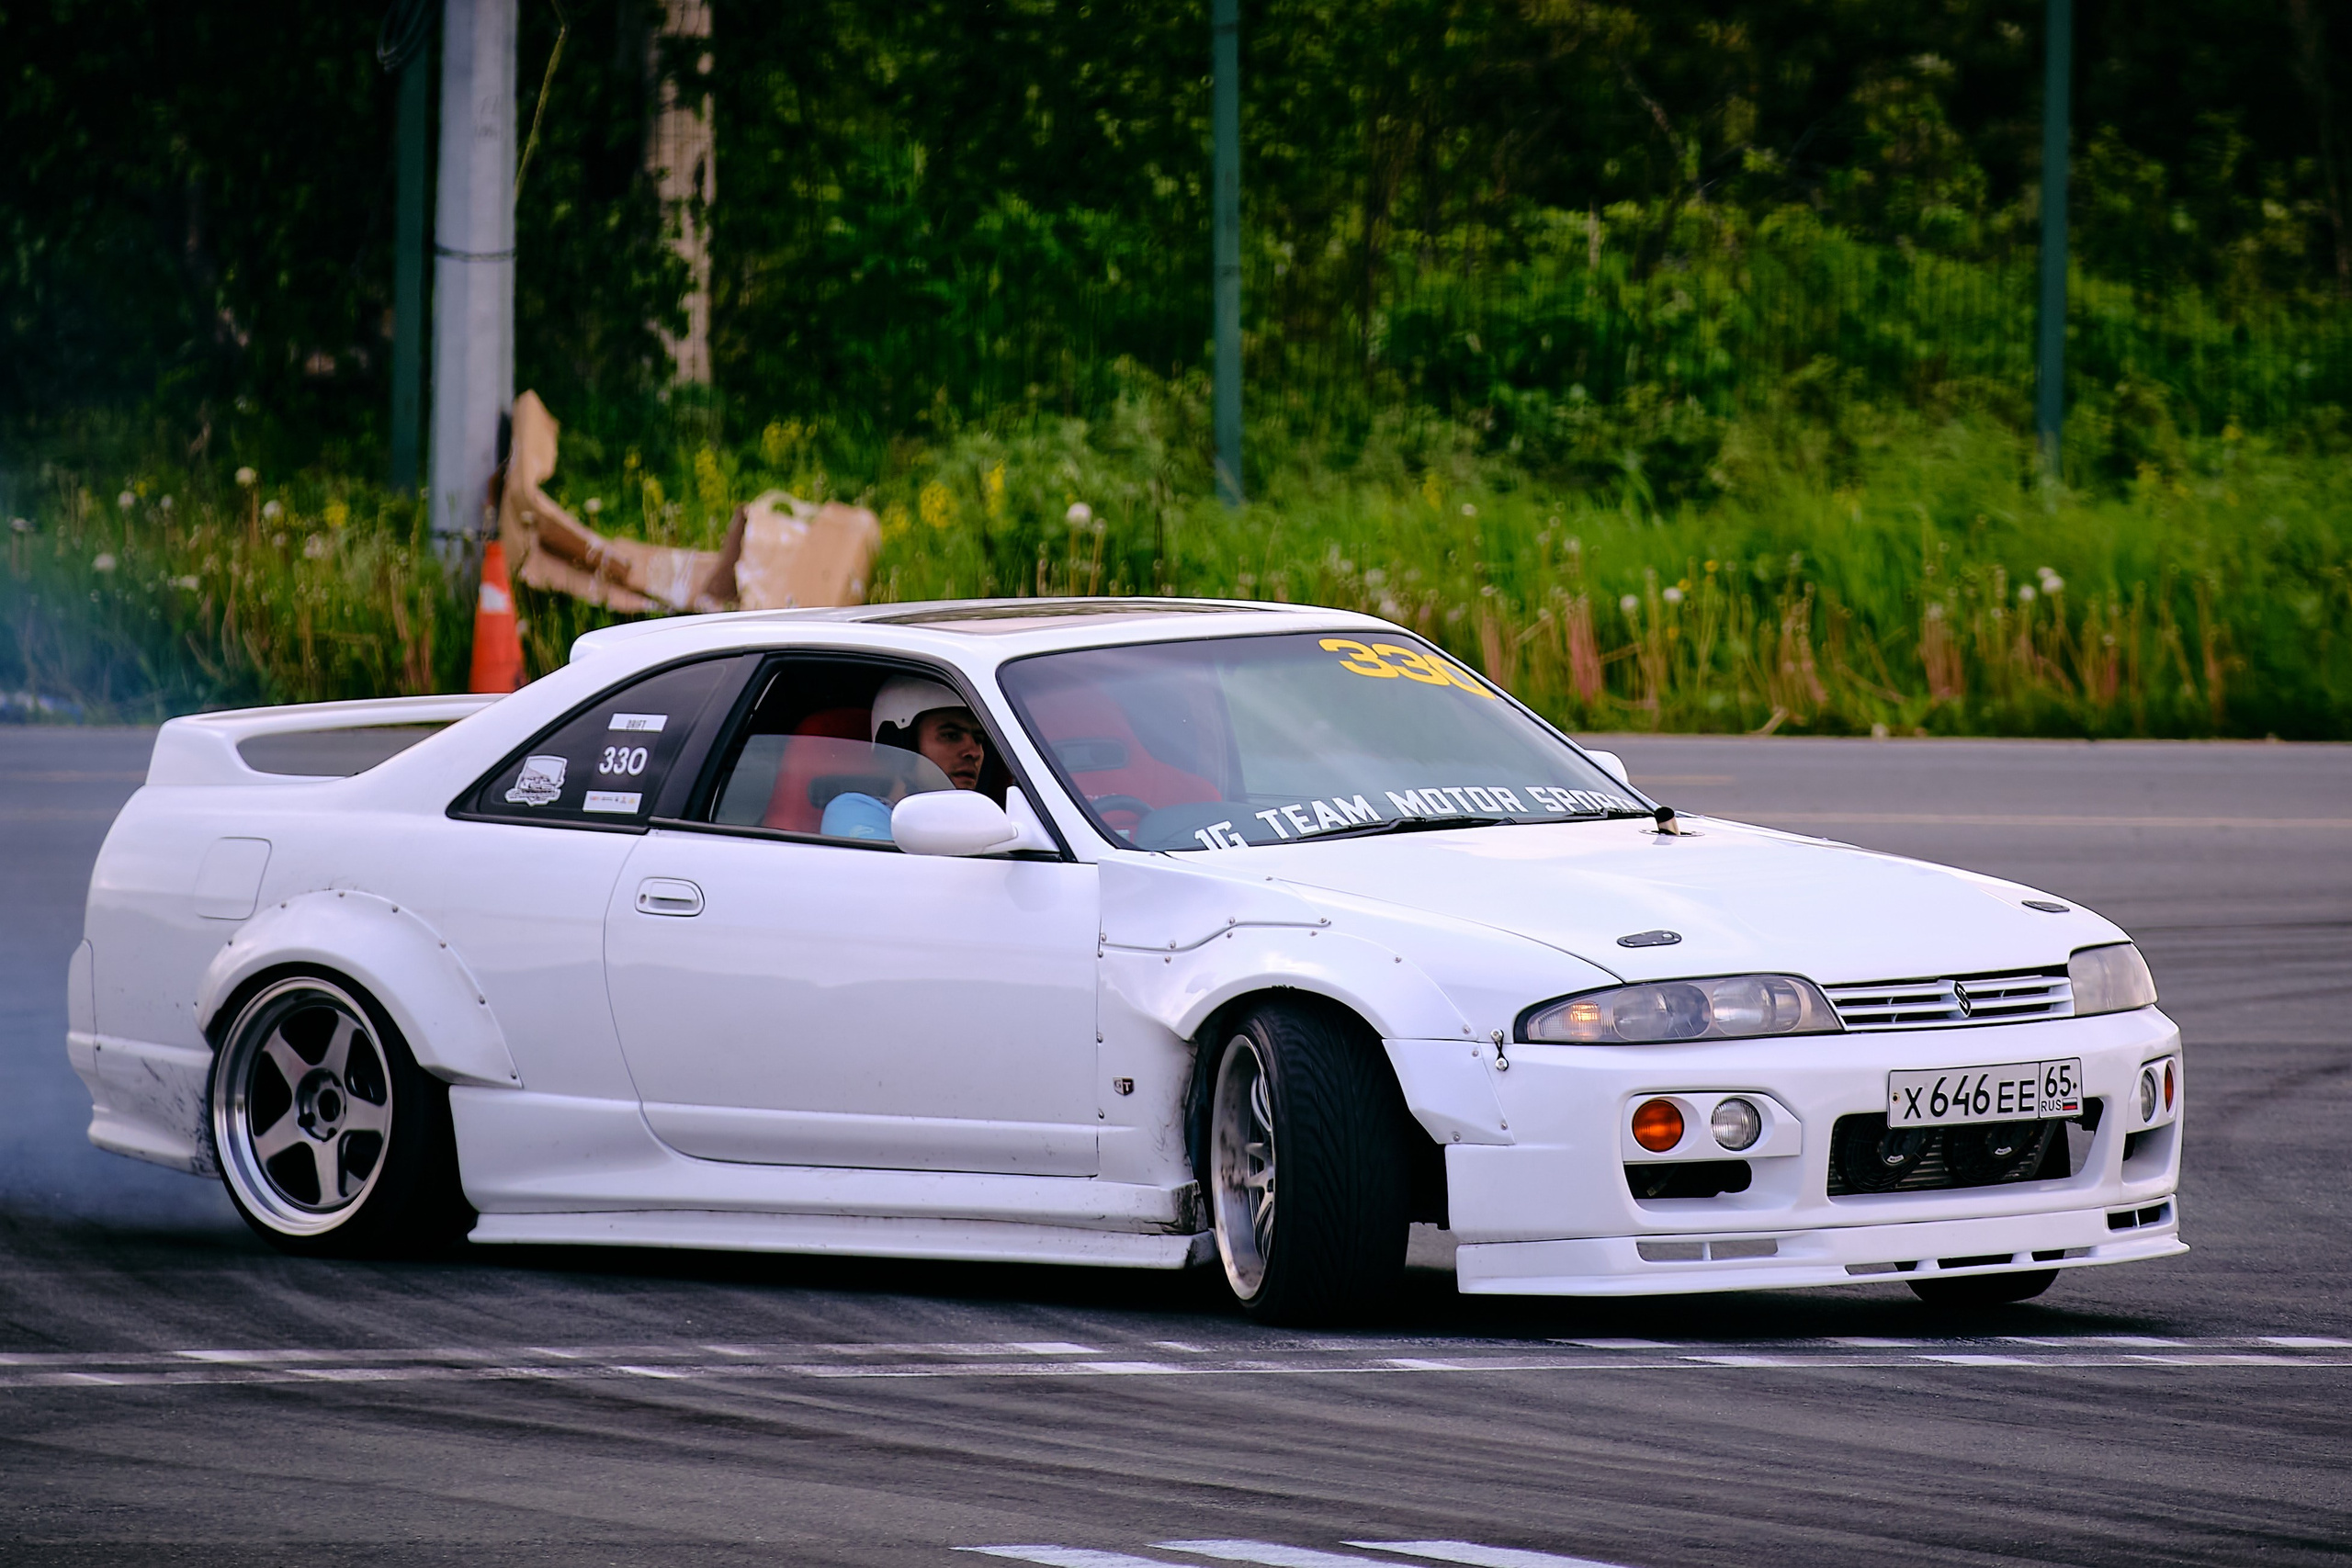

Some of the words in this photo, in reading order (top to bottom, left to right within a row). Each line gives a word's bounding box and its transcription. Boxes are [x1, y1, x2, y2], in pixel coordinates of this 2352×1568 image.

[1318, 638, 1496, 700] 330
[599, 746, 648, 776] 330
[1255, 795, 1383, 840] TEAM
[1384, 786, 1530, 818] MOTOR
[2044, 1065, 2072, 1098] 65
[2041, 1100, 2062, 1112] RUS
